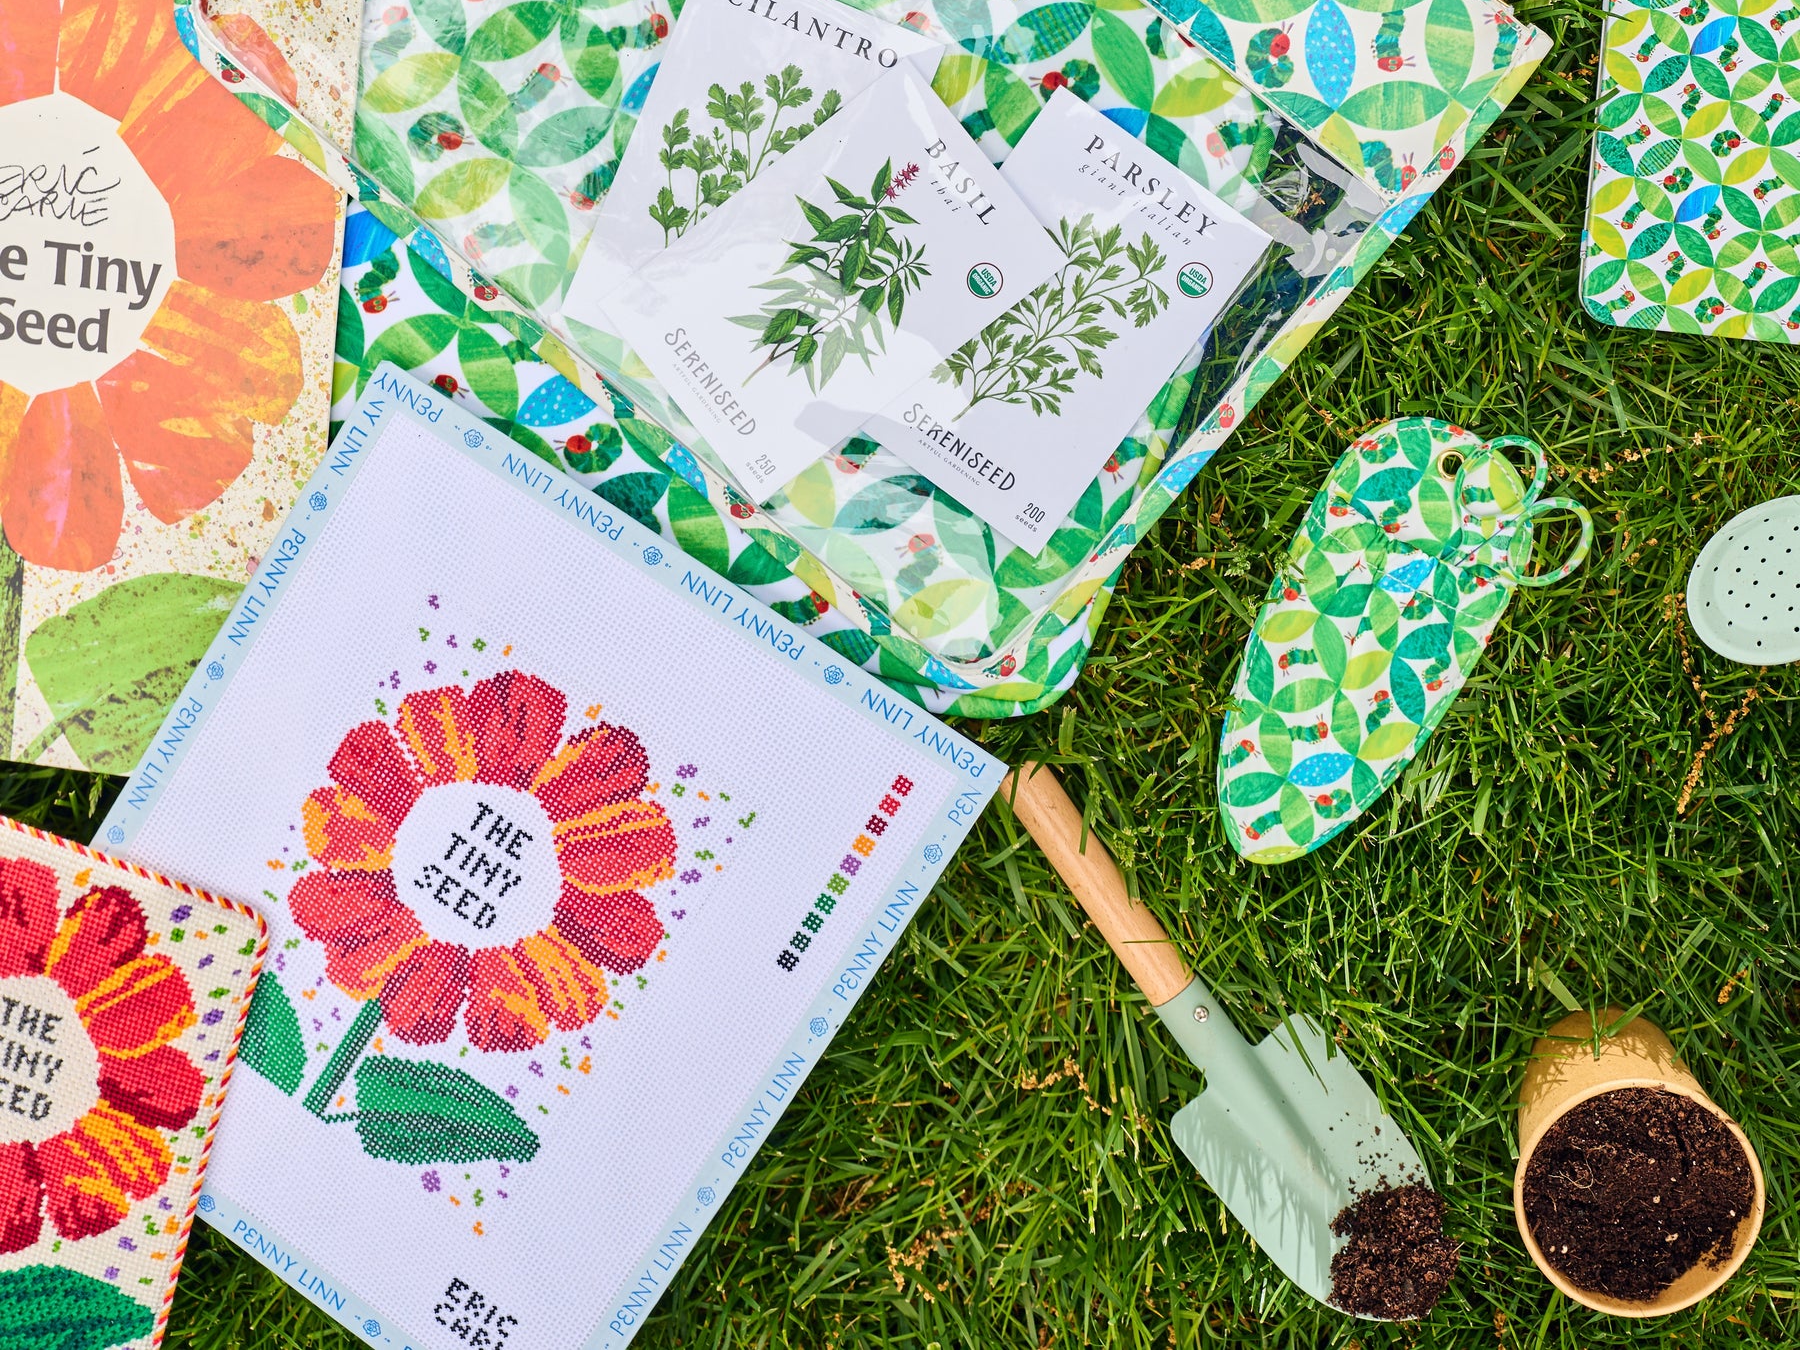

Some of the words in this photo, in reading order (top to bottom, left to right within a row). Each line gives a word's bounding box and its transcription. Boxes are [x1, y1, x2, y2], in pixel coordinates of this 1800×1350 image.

[924, 137, 996, 226] BASIL
[930, 179, 962, 213] thai
[1077, 163, 1127, 196] giant
[1132, 199, 1192, 246] italian
[1083, 134, 1218, 236] PARSLEY
[43, 240, 163, 311] Tiny
[972, 272, 991, 295] ORGANIC
[980, 267, 998, 288] USDA
[1181, 275, 1205, 294] ORGANIC
[1188, 267, 1208, 285] USDA
[373, 372, 445, 424] PENNY
[664, 327, 757, 436] SERENISEED
[671, 363, 692, 387] ARTFUL
[691, 387, 722, 425] GARDENING
[329, 425, 369, 477] LINN
[501, 452, 555, 495] LINN
[745, 461, 765, 484] seeds
[755, 453, 777, 476] 250
[903, 402, 1016, 491] SERENISEED
[917, 439, 942, 459] ARTFUL
[943, 457, 982, 486] GARDENING
[553, 488, 626, 542] PENNY
[1014, 513, 1038, 533] seeds
[1022, 502, 1046, 524] 200
[258, 527, 307, 598] PENNY
[227, 594, 266, 646] LINN
[680, 570, 735, 621] LINN
[732, 608, 806, 662] PENNY
[157, 696, 203, 764] PENNY
[860, 687, 915, 731] LINN
[913, 724, 987, 778] PENNY
[127, 762, 163, 811] LINN
[470, 801, 534, 861] THE
[444, 832, 522, 898] TINY
[413, 864, 497, 930] SEED
[832, 931, 885, 1001] PENNY
[877, 879, 920, 933] LINN
[2, 995, 63, 1045] THE
[0, 1035, 64, 1084] INY
[721, 1100, 771, 1170] PENNY
[766, 1051, 806, 1102] LINN
[233, 1219, 298, 1273] PENNY
[298, 1269, 347, 1312] LINN
[609, 1269, 660, 1337] PENNY
[653, 1221, 693, 1272] LINN
[445, 1277, 518, 1338] ERIC
